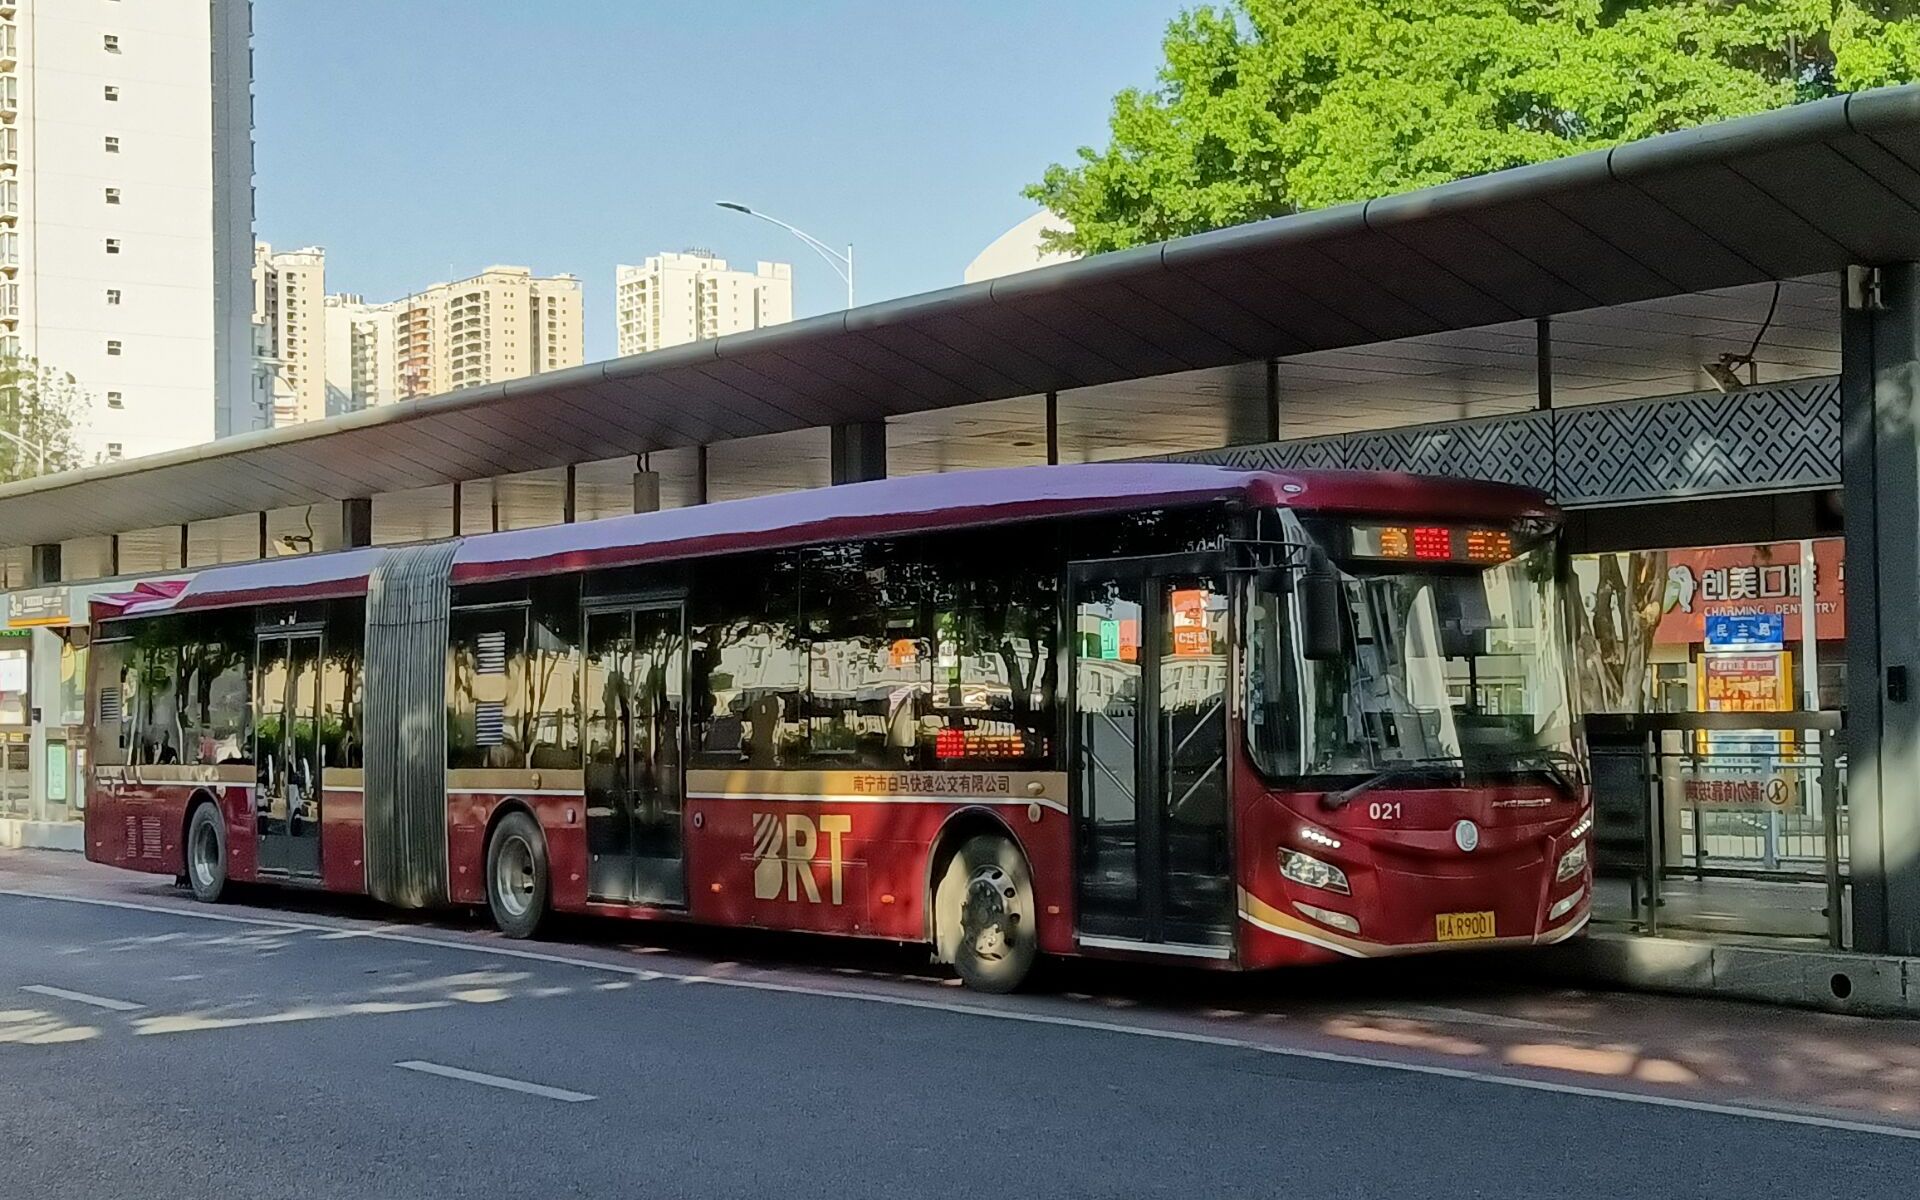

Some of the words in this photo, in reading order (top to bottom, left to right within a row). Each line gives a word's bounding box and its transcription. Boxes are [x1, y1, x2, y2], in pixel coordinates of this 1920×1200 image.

[1704, 604, 1765, 617] CHARMING
[1775, 602, 1837, 615] DENTTRY
[853, 774, 1010, 793] 南宁市白马快速公交有限公司
[1369, 802, 1401, 820] 021
[752, 813, 852, 906] BRT
